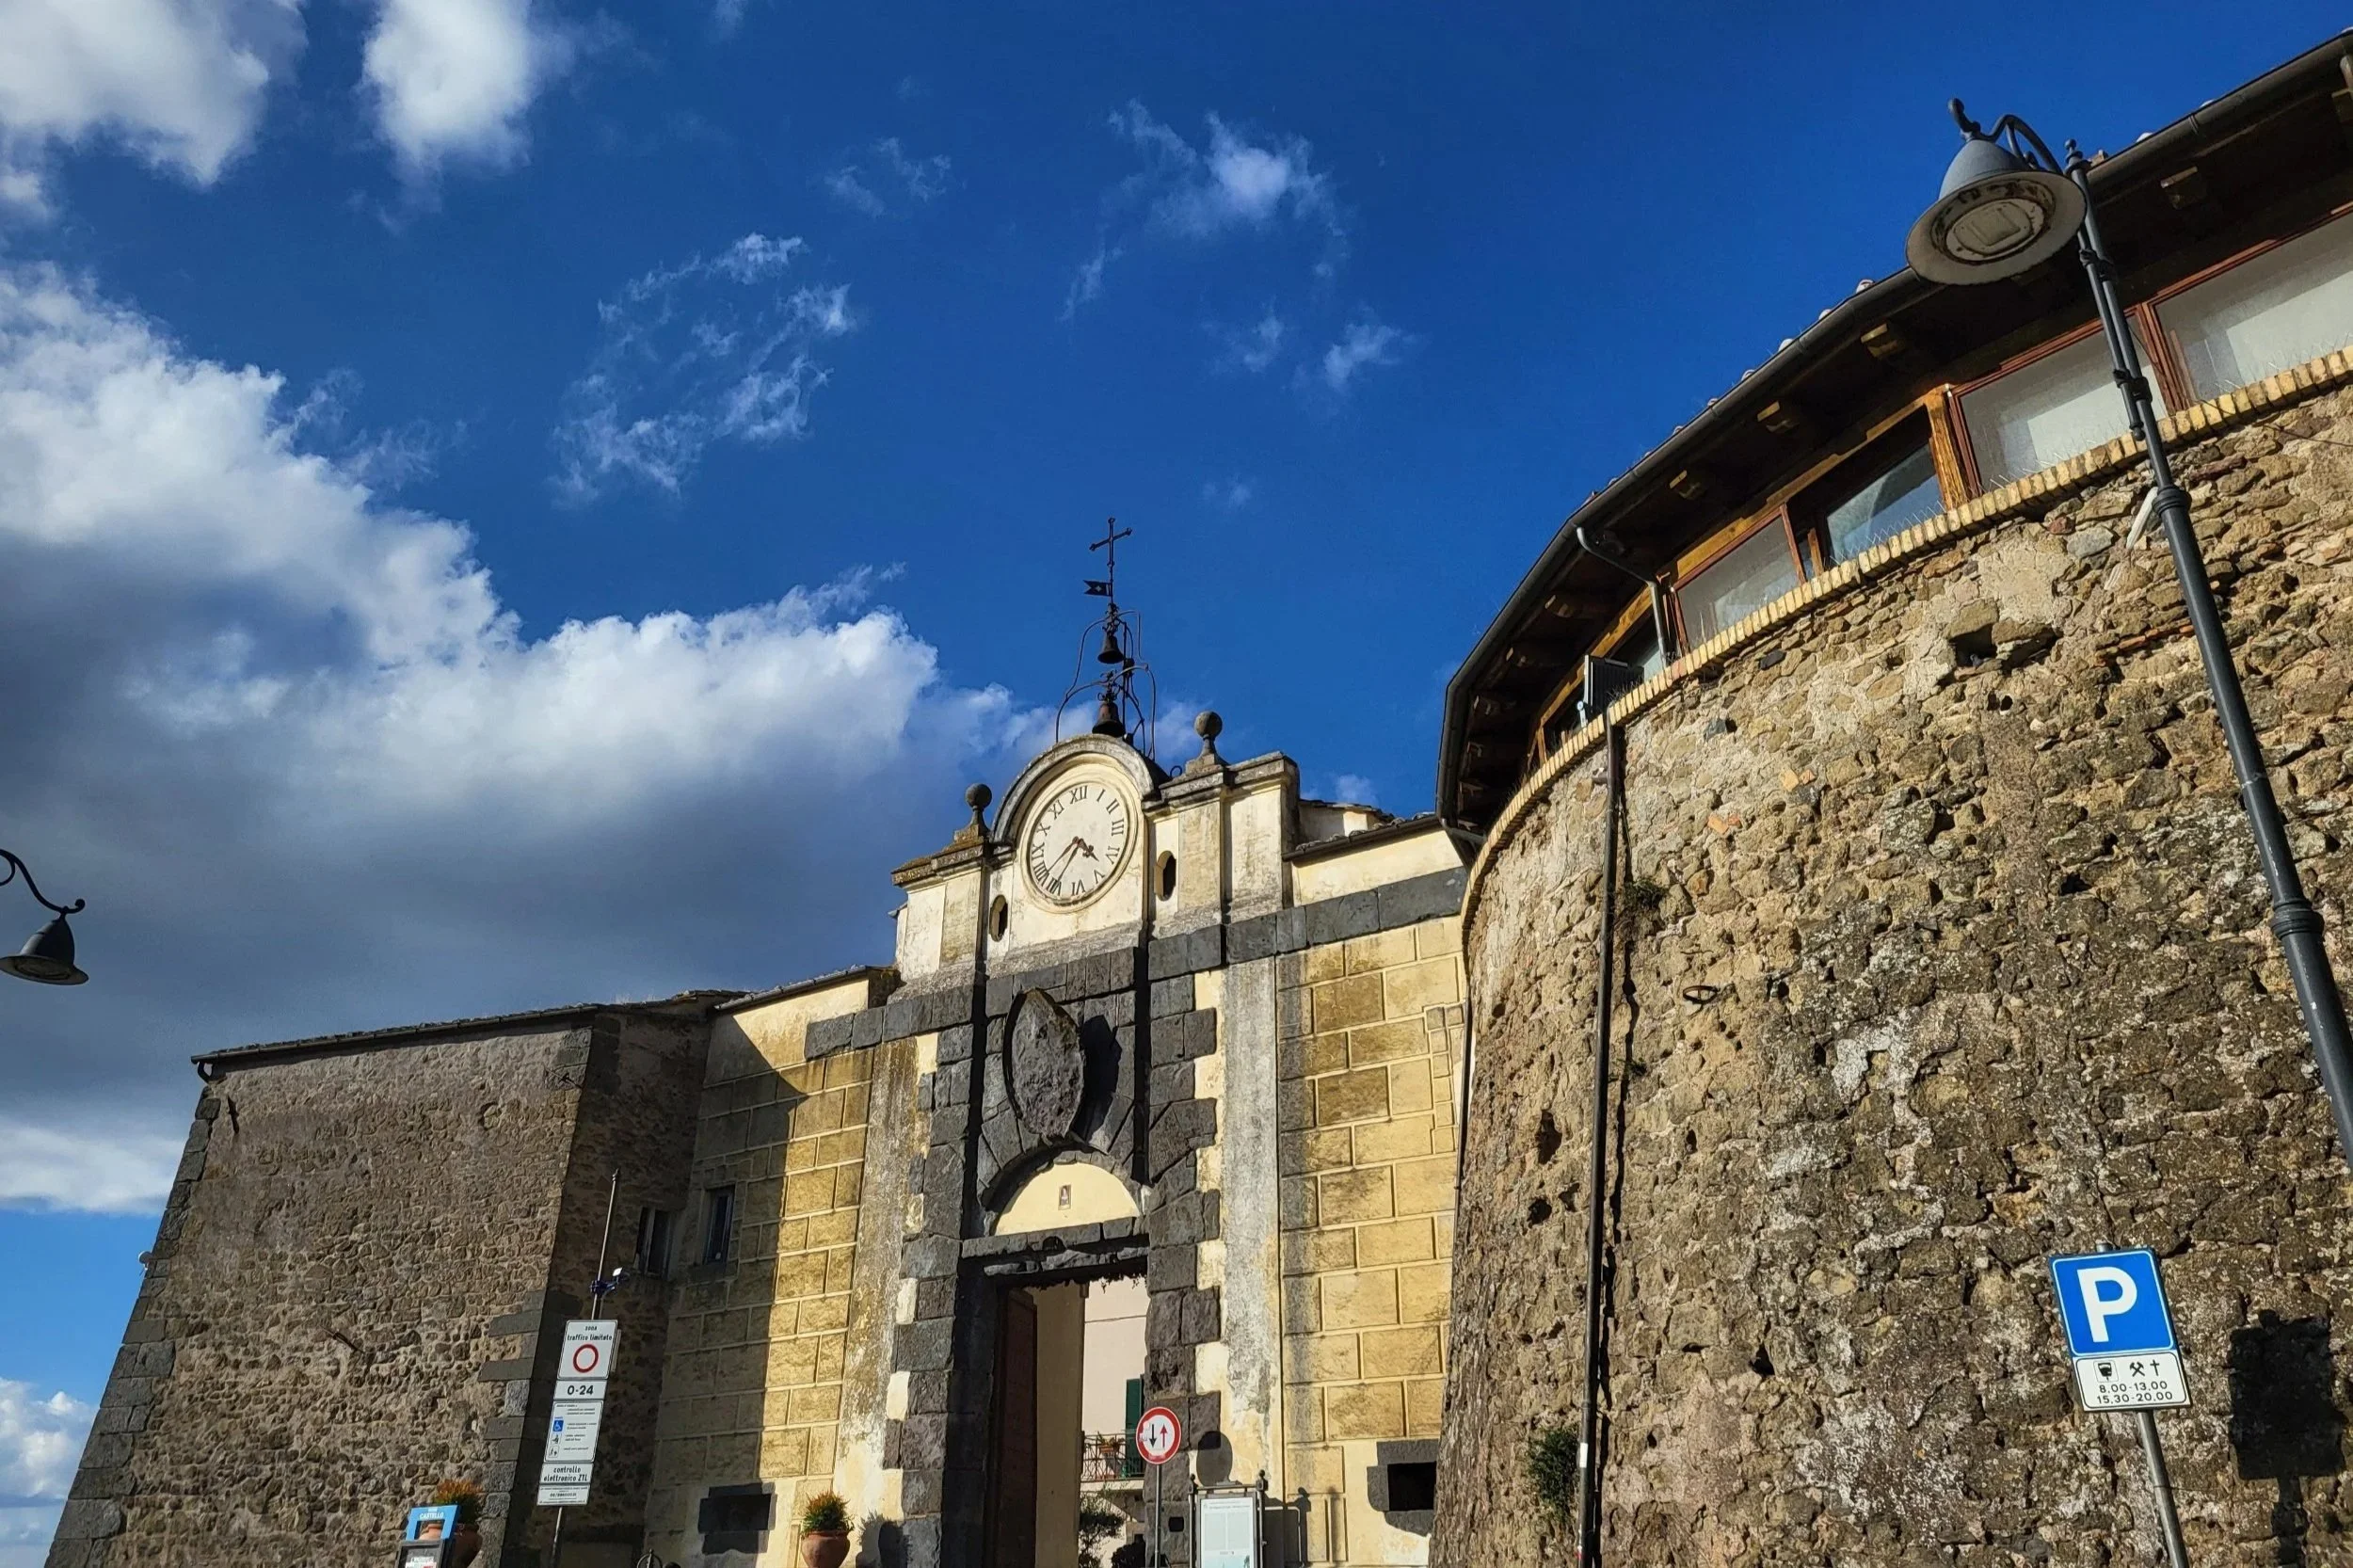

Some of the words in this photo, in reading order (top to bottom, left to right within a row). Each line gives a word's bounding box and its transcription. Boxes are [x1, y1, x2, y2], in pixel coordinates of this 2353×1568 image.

[1070, 785, 1088, 805] XII
[1096, 789, 1106, 802] I
[1048, 799, 1064, 820] XI
[1106, 798, 1120, 814] II
[1036, 823, 1050, 836] X
[1112, 819, 1125, 836] III
[1032, 842, 1045, 859] IX
[1106, 845, 1120, 865] IV
[1093, 870, 1106, 884] V
[1071, 879, 1086, 896] VI
[2077, 1266, 2137, 1343] P
[2099, 1381, 2168, 1394] 8.00-13.00
[2096, 1391, 2173, 1404] 15.30-20.00
[543, 1473, 577, 1481] elettronico
